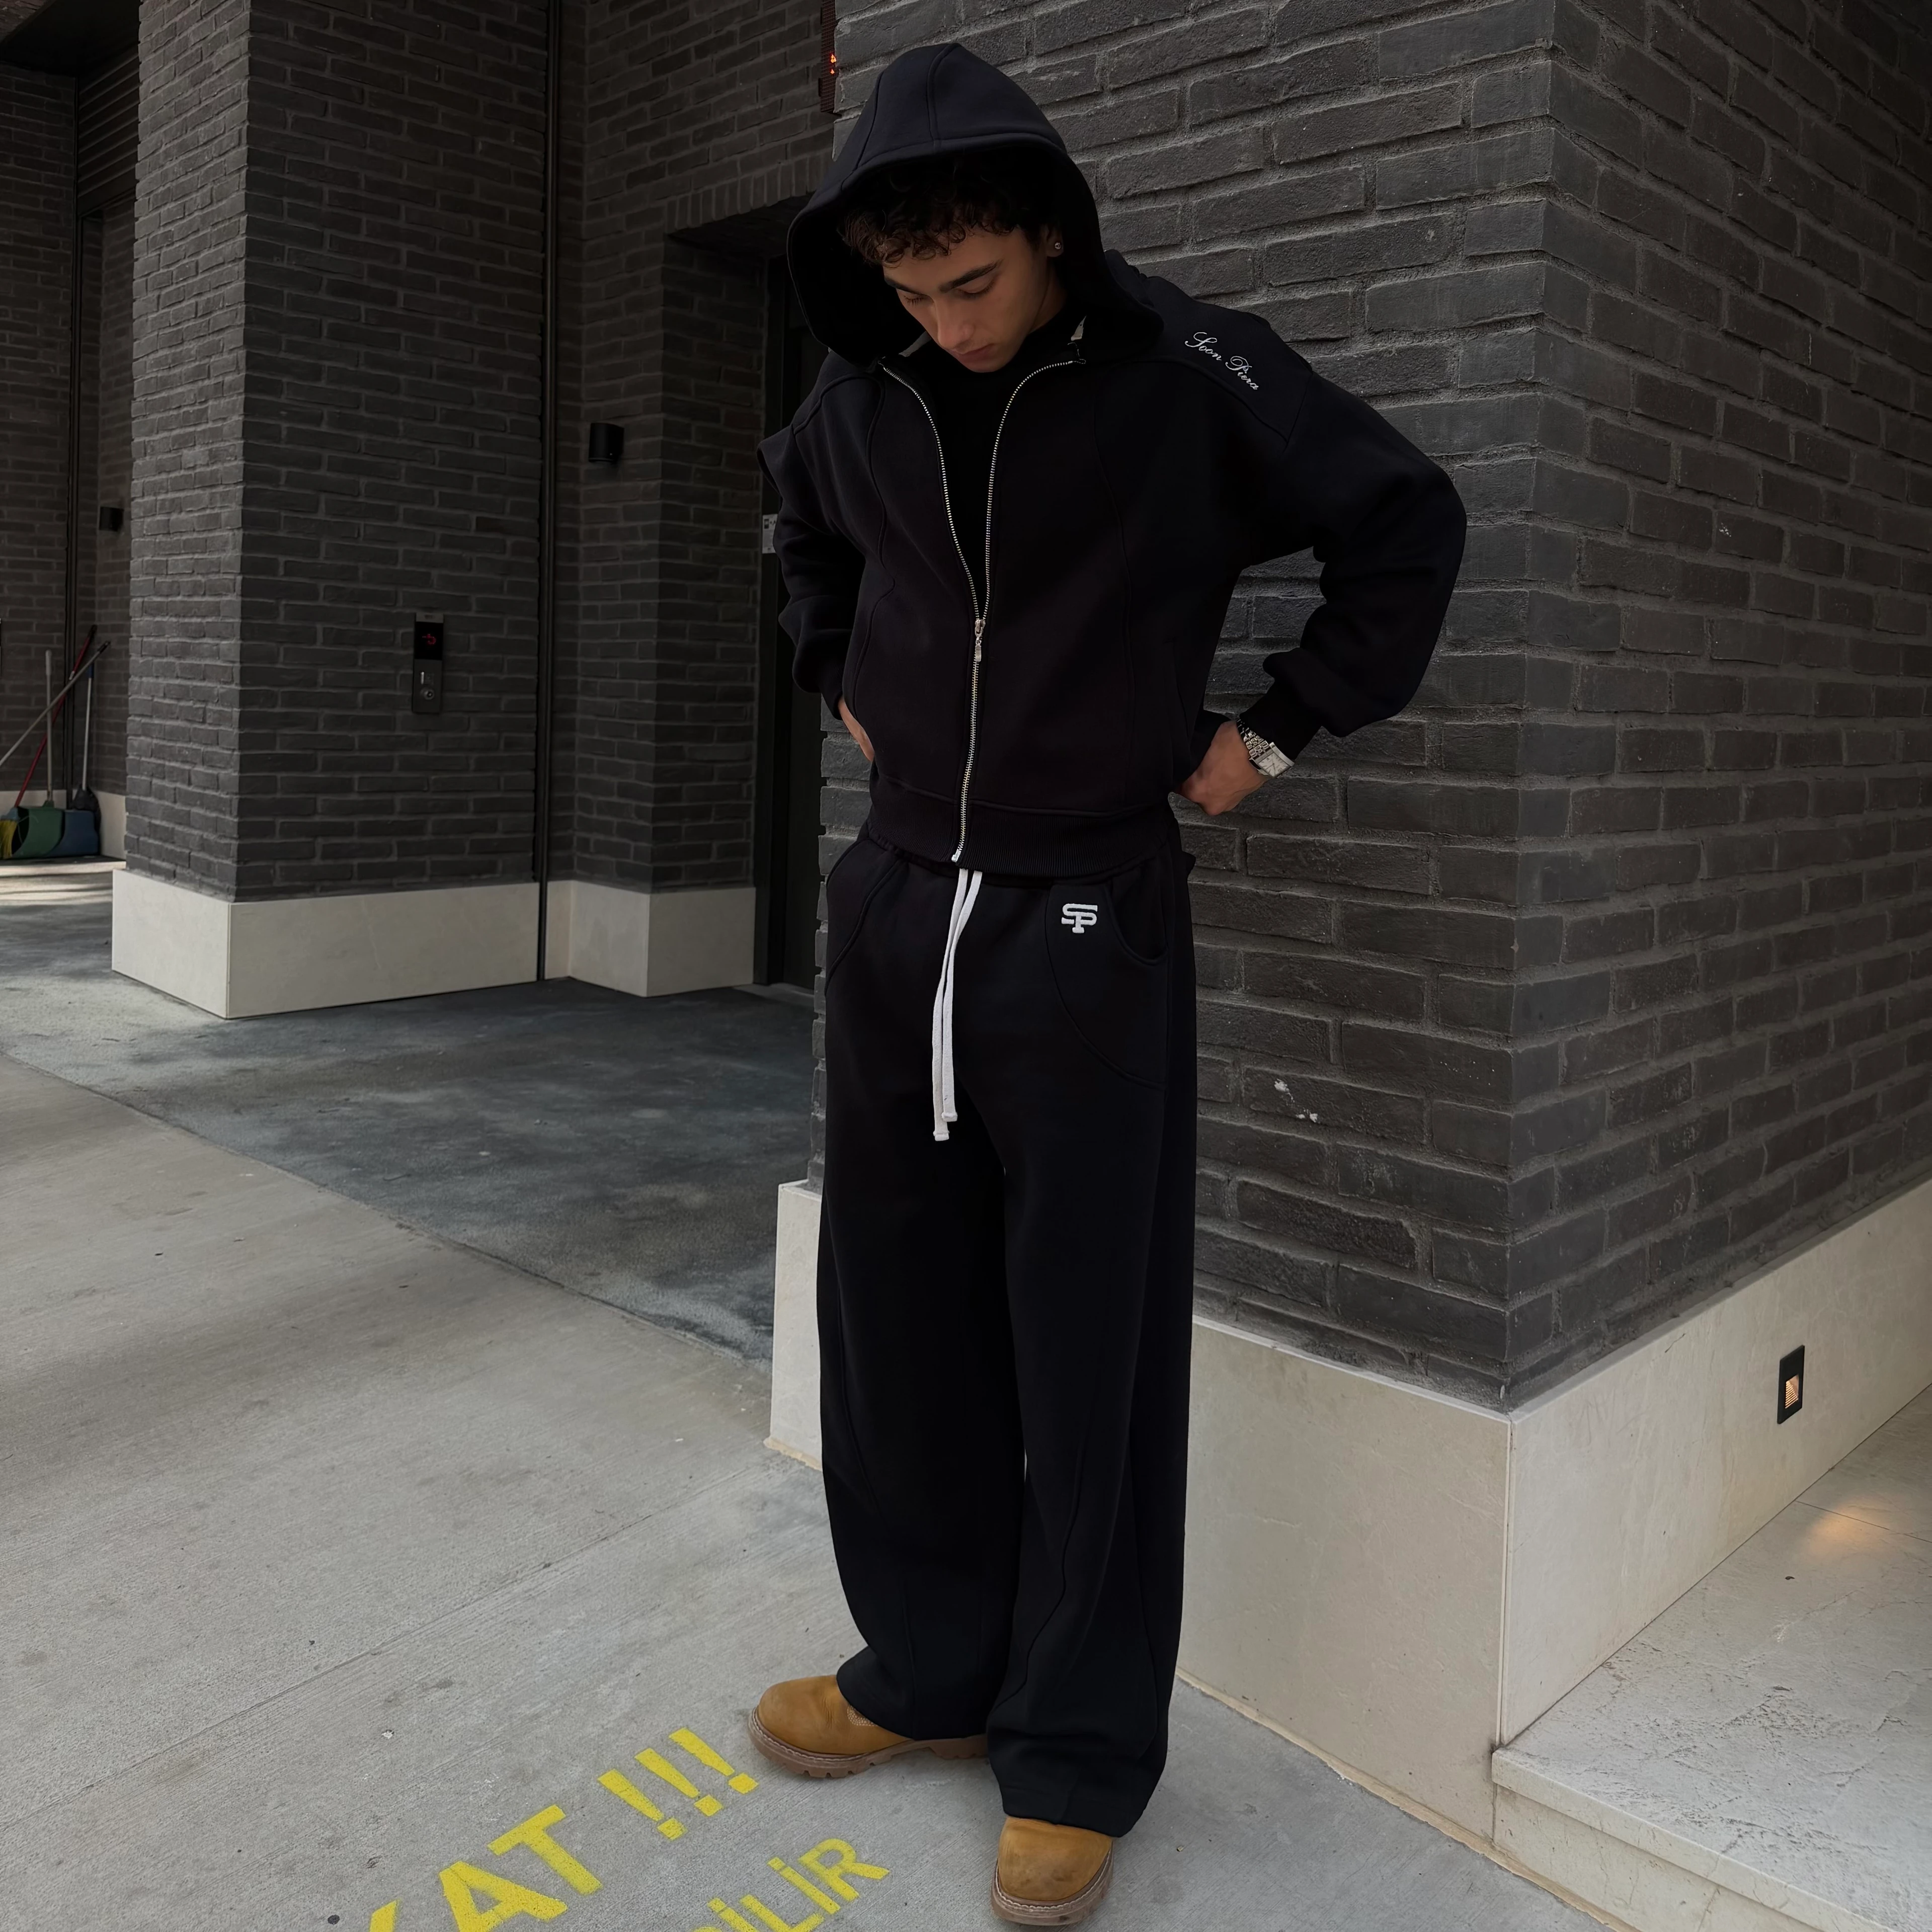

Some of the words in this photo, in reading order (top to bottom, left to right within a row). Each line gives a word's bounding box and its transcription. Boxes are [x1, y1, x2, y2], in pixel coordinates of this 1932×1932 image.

[1184, 332, 1222, 361] Soon
[1061, 903, 1098, 934] SP
[369, 1804, 602, 1932] AT
[597, 1728, 758, 1840] !!!
[693, 1838, 890, 1932] İLİR
